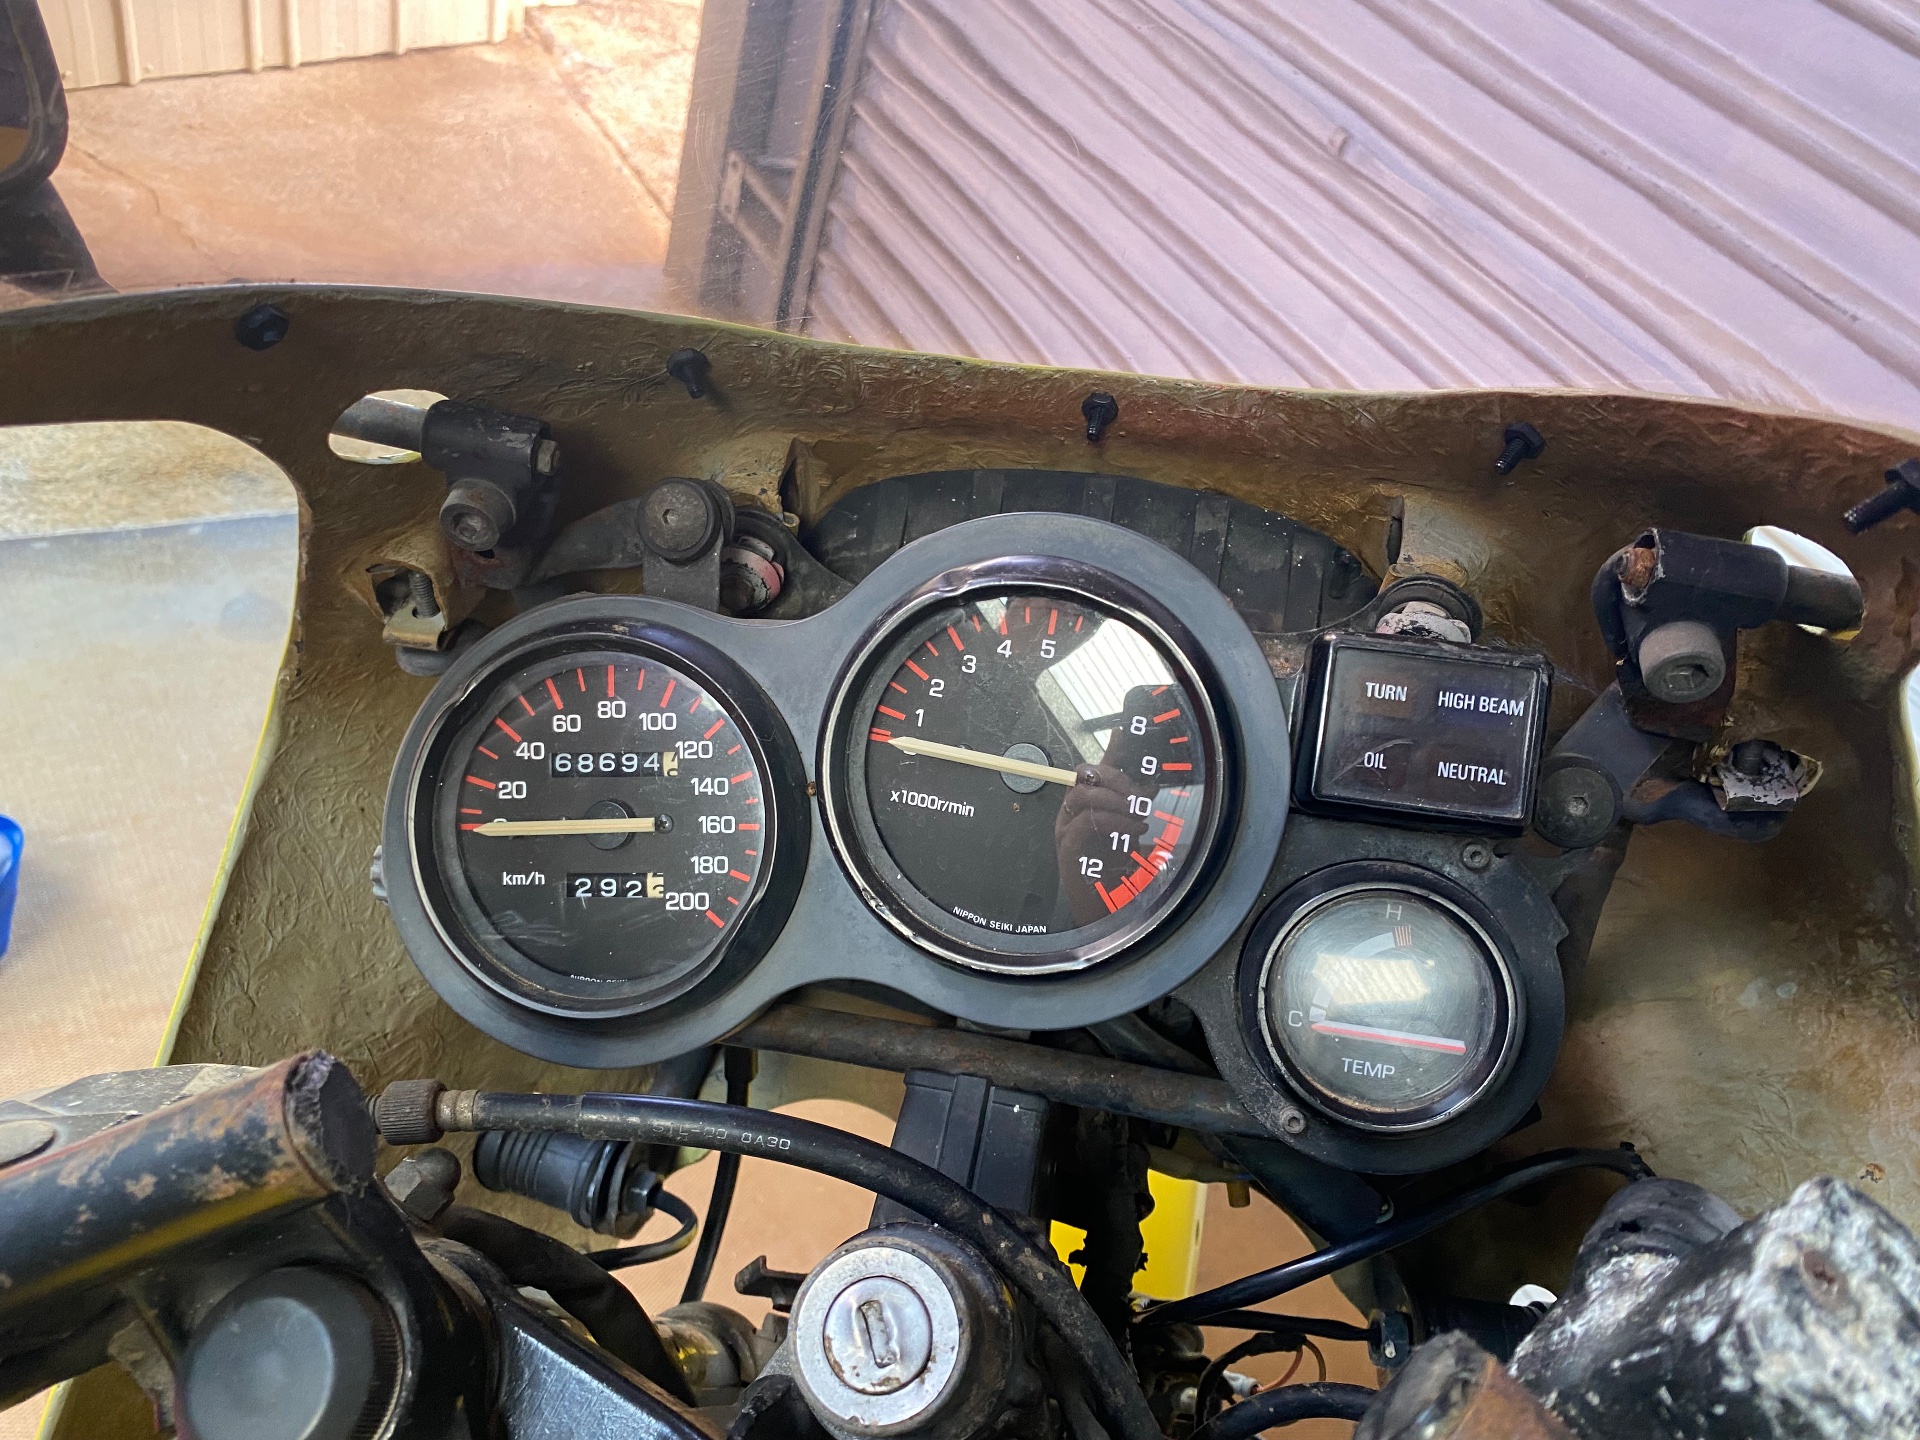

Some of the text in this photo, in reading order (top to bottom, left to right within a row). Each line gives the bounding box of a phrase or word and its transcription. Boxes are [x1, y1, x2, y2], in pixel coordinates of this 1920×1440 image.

[996, 639, 1012, 658] 4
[1040, 640, 1056, 659] 5
[961, 655, 977, 674] 3
[928, 678, 945, 698] 2
[1365, 682, 1407, 701] TURN
[597, 701, 626, 719] 80
[1438, 691, 1525, 717] HIGH BEAM
[552, 715, 582, 733] 60
[638, 713, 677, 731] 100
[915, 708, 925, 727] 1
[1130, 715, 1147, 736] 8
[515, 742, 545, 760] 40
[675, 740, 713, 759] 120
[1140, 755, 1157, 776] 9
[1363, 752, 1387, 770] OIL
[1438, 761, 1507, 786] NEUTRAL
[498, 780, 527, 799] 20
[690, 776, 729, 796] 140
[1127, 793, 1152, 817] 10
[698, 815, 736, 834] 160
[1109, 831, 1131, 853] 11
[690, 855, 729, 874] 180
[1078, 856, 1104, 879] 12
[502, 871, 546, 886] km/h
[665, 892, 710, 911] 200
[952, 906, 1047, 934] NIPPON SEIKI JAPAN
[1385, 903, 1403, 921] H
[1288, 1010, 1304, 1027] C
[1341, 1057, 1396, 1079] TEMP
